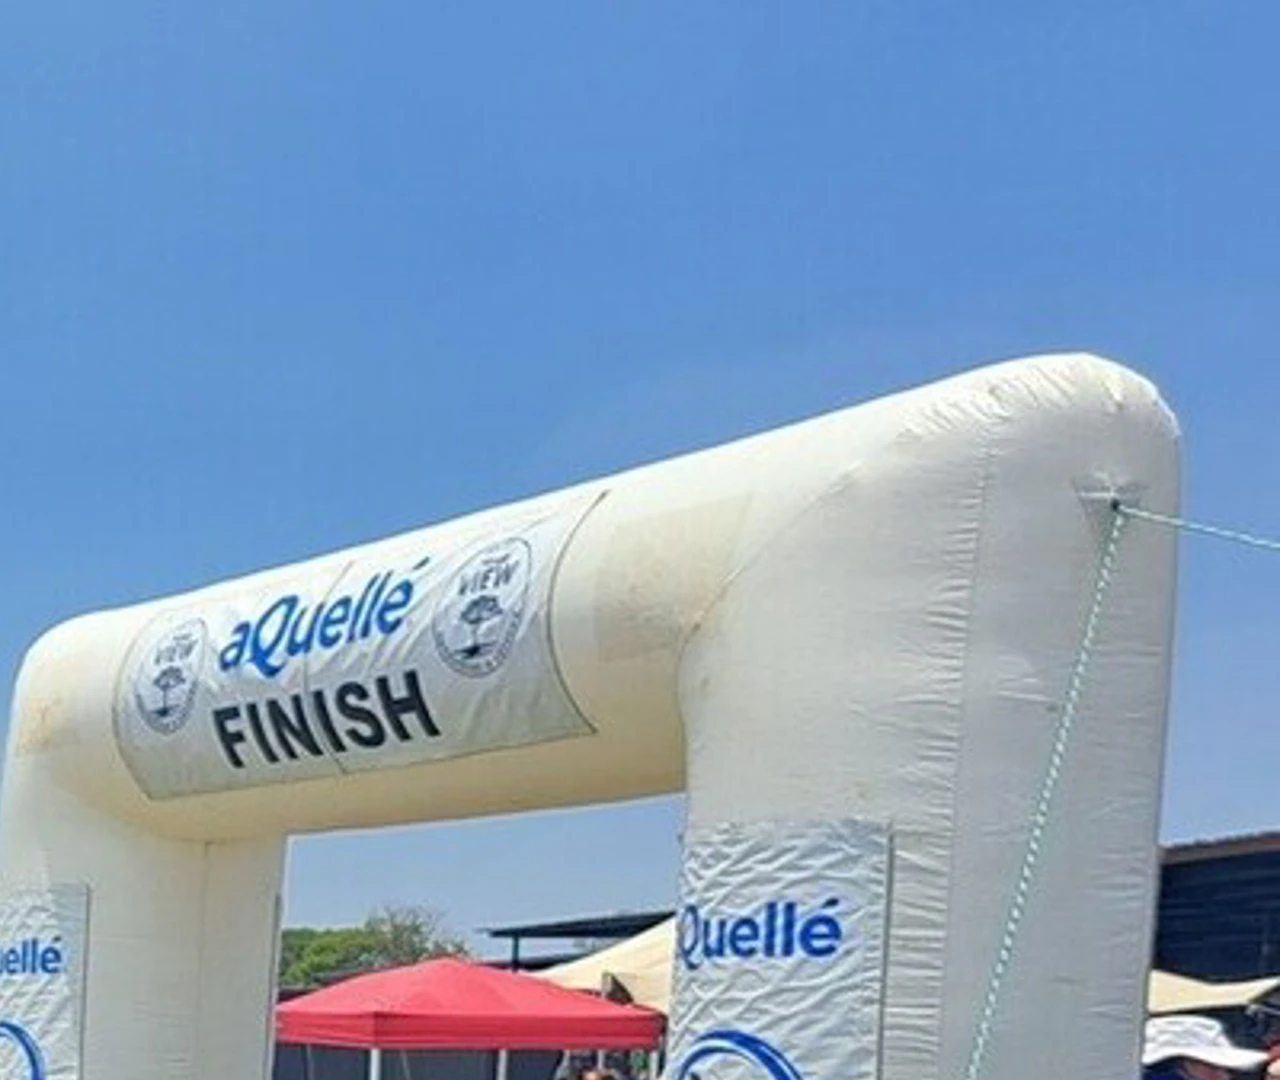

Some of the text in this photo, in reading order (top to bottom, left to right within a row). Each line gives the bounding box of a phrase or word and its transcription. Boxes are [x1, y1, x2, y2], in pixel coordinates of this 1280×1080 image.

[219, 557, 430, 679] aQuellé
[458, 559, 519, 596] VIEW
[212, 669, 442, 769] FINISH
